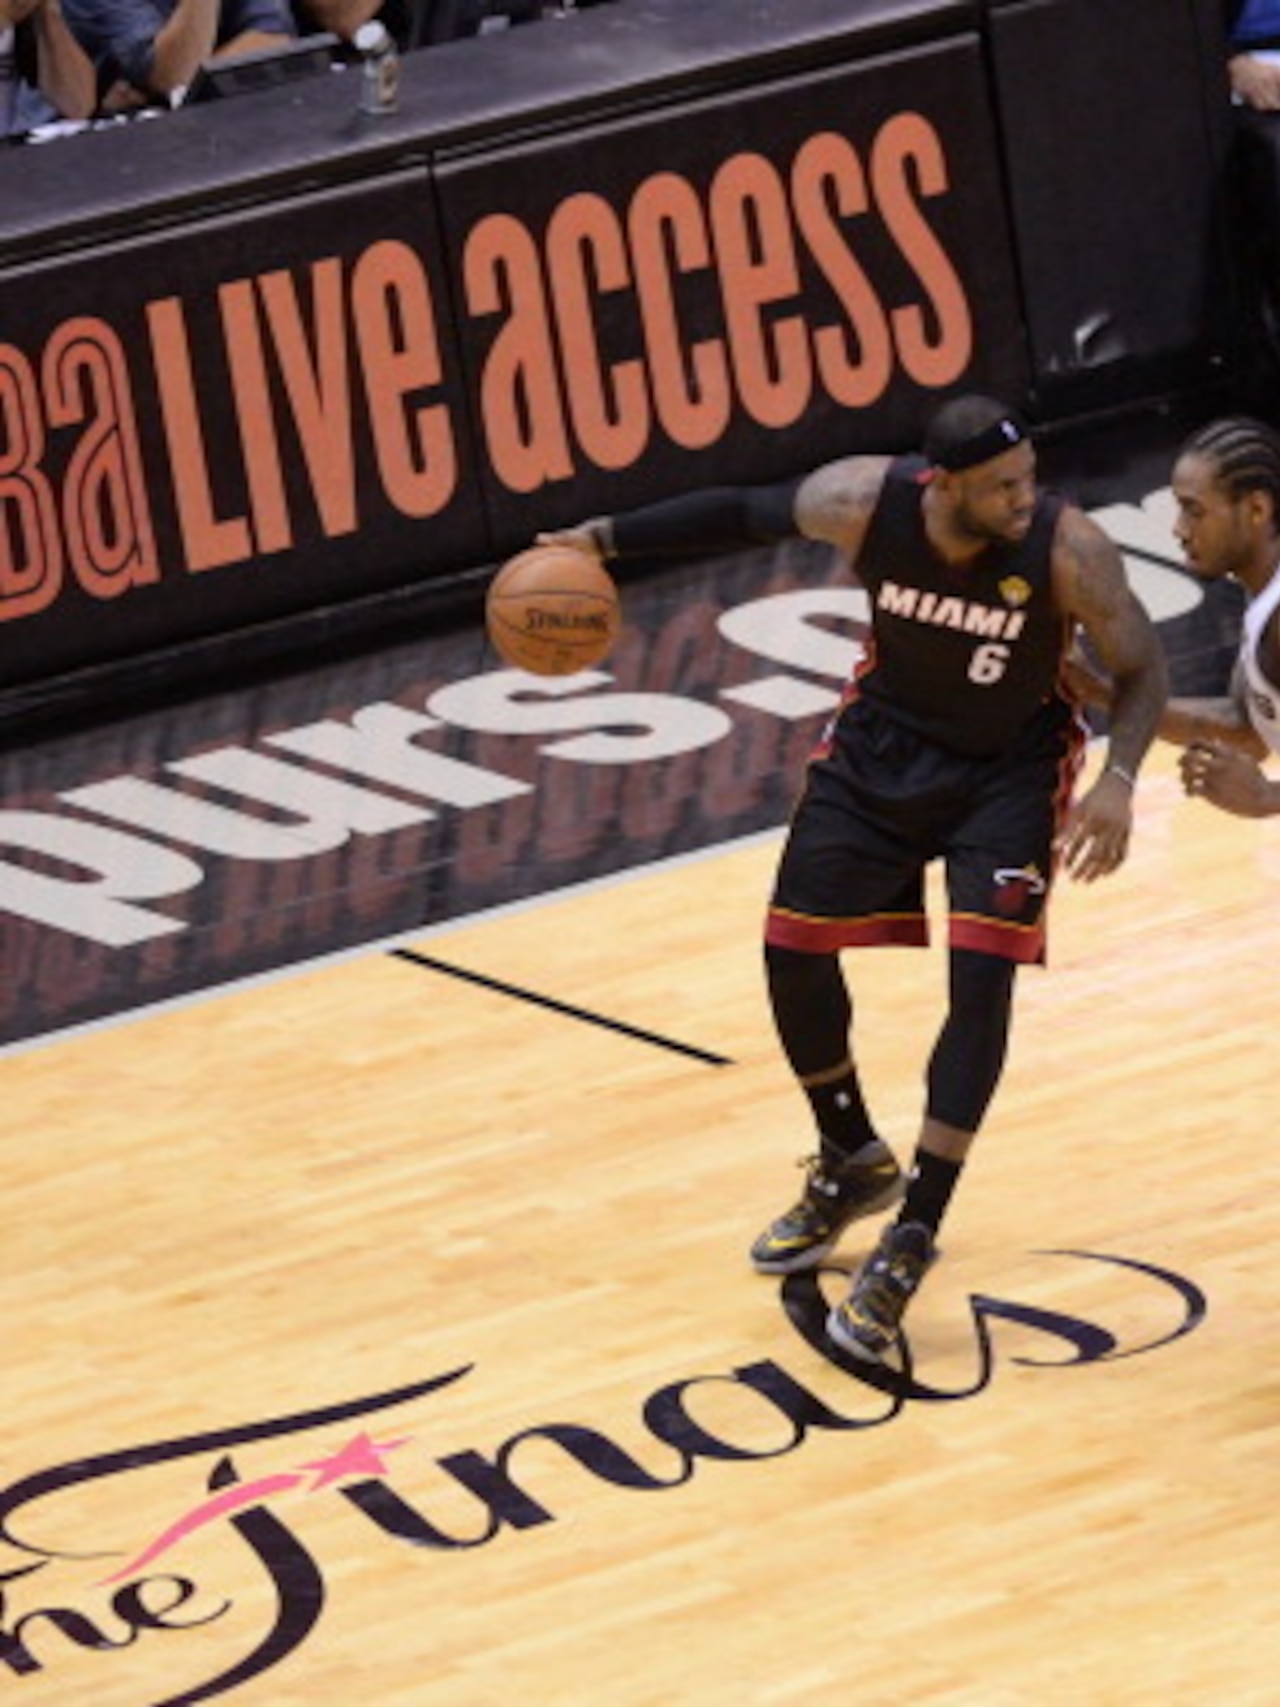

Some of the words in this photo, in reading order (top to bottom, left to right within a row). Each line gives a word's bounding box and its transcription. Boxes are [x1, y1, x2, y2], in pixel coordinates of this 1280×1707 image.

[526, 607, 610, 631] SPALDING
[877, 579, 1026, 641] MIAMI
[966, 642, 1011, 685] 6
